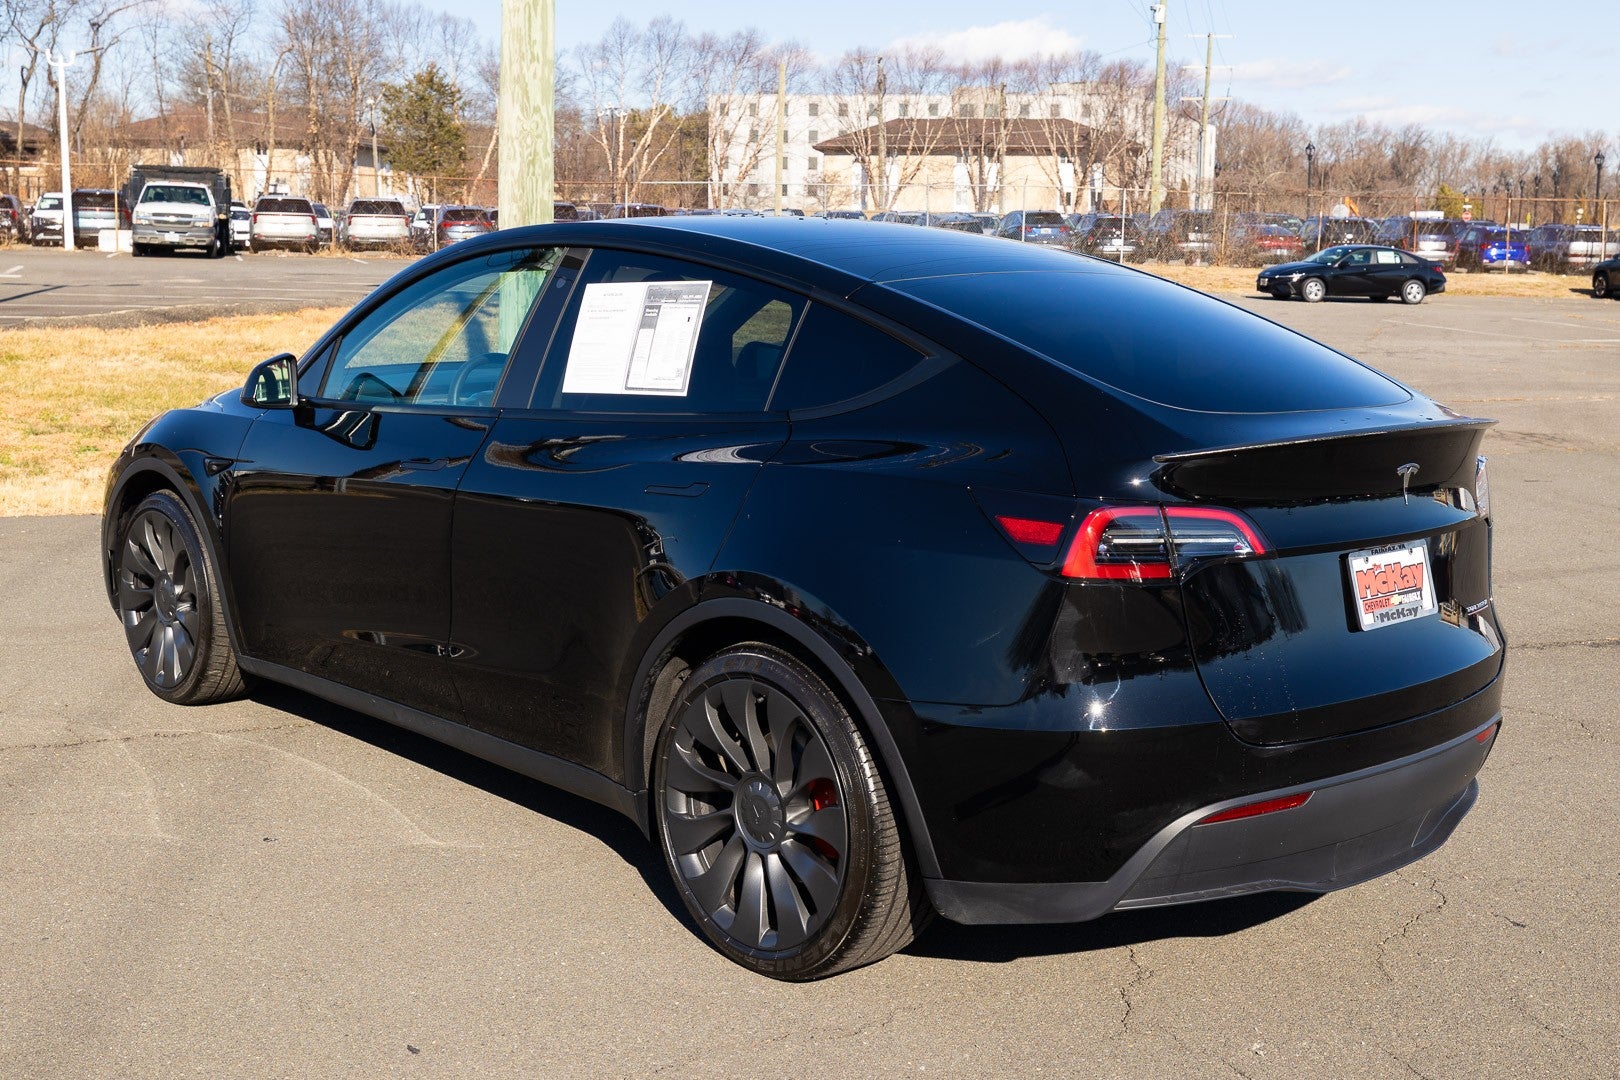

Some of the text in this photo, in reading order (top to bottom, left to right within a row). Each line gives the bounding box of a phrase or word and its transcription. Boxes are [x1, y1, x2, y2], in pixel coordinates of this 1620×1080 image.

[1356, 562, 1423, 599] McKay
[1364, 598, 1391, 611] CHEVROLET
[1380, 605, 1419, 622] McKay
